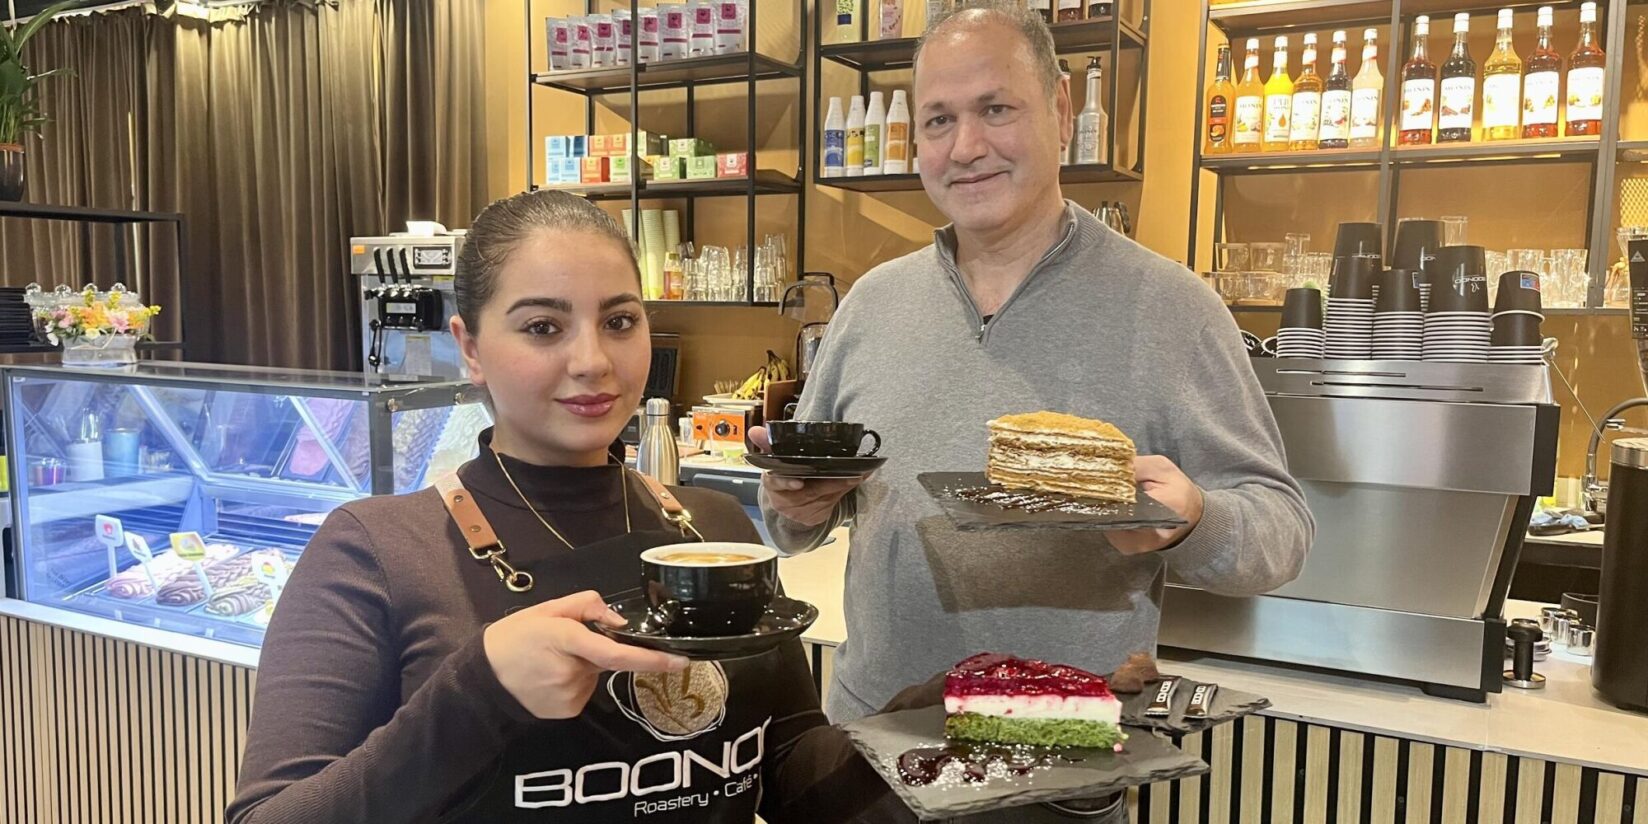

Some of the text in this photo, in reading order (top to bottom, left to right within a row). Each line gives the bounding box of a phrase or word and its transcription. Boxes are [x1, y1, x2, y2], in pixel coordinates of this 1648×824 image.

[514, 726, 763, 809] BOONO
[633, 774, 753, 817] Roastery Café
